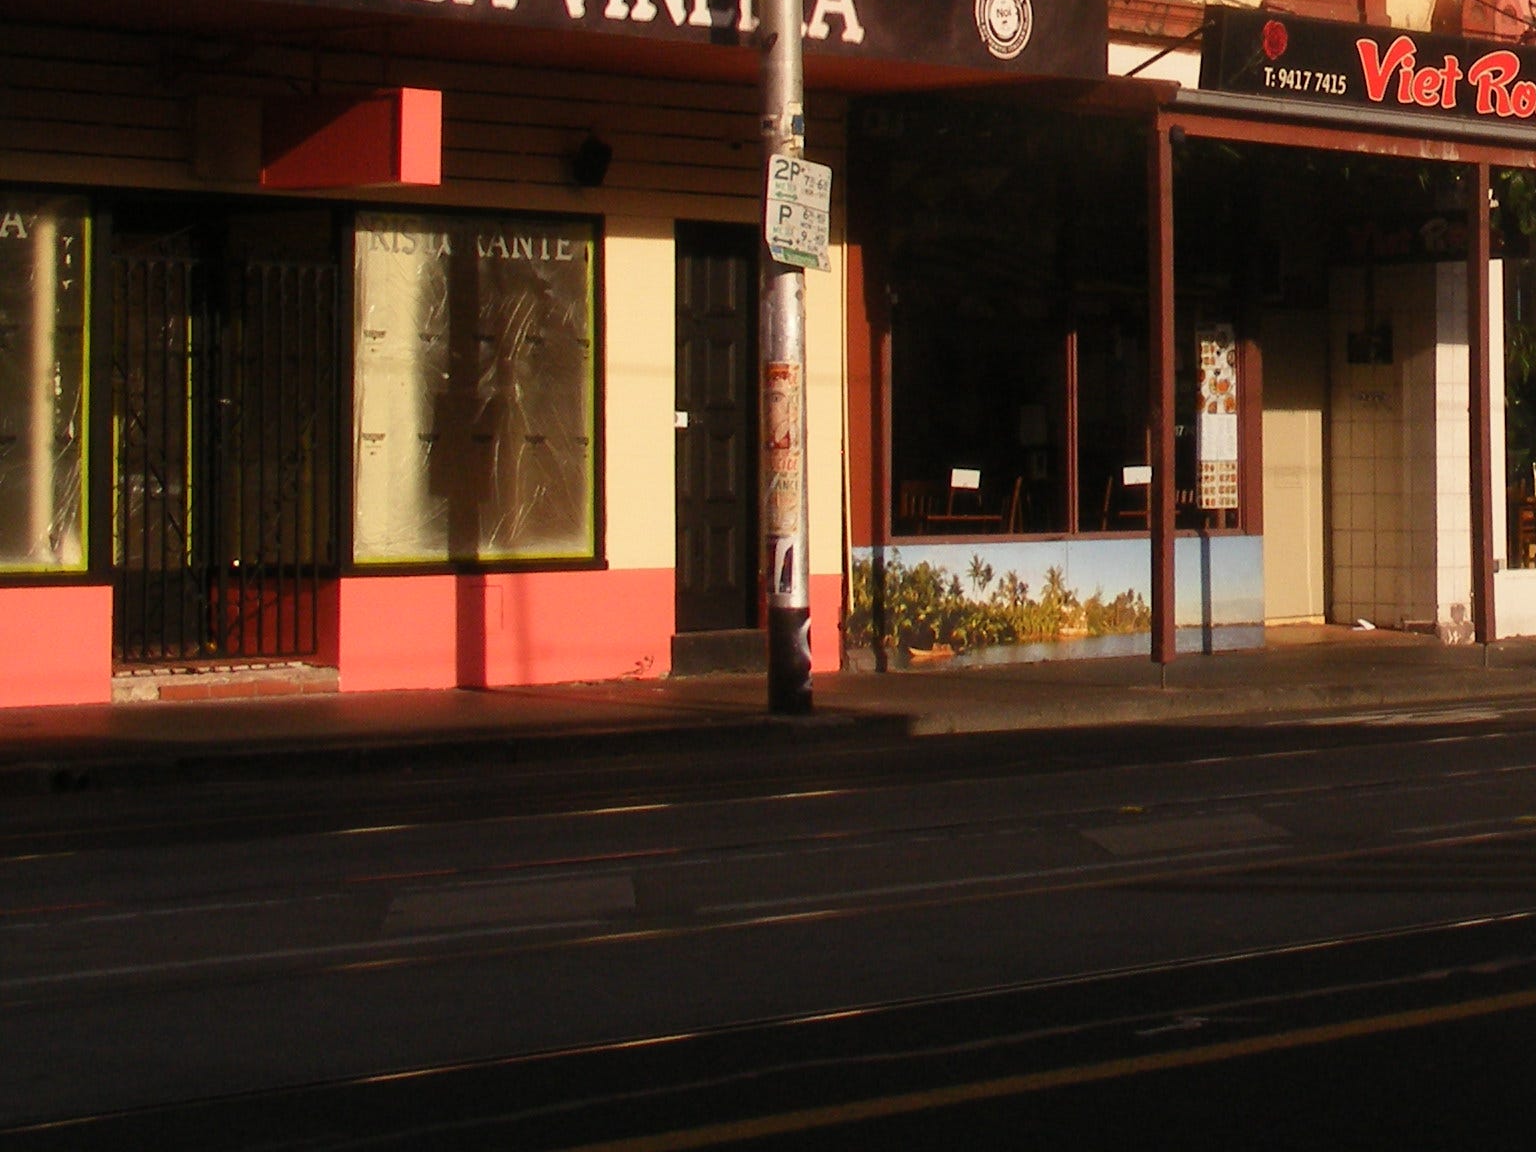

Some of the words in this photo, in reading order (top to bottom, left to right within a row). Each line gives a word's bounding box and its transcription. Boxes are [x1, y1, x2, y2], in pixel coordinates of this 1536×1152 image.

[1264, 66, 1276, 88] T:
[1278, 67, 1311, 92] 9417
[1314, 71, 1347, 96] 7415
[1356, 35, 1463, 109] Viet
[775, 159, 800, 181] 2P
[779, 204, 792, 225] P
